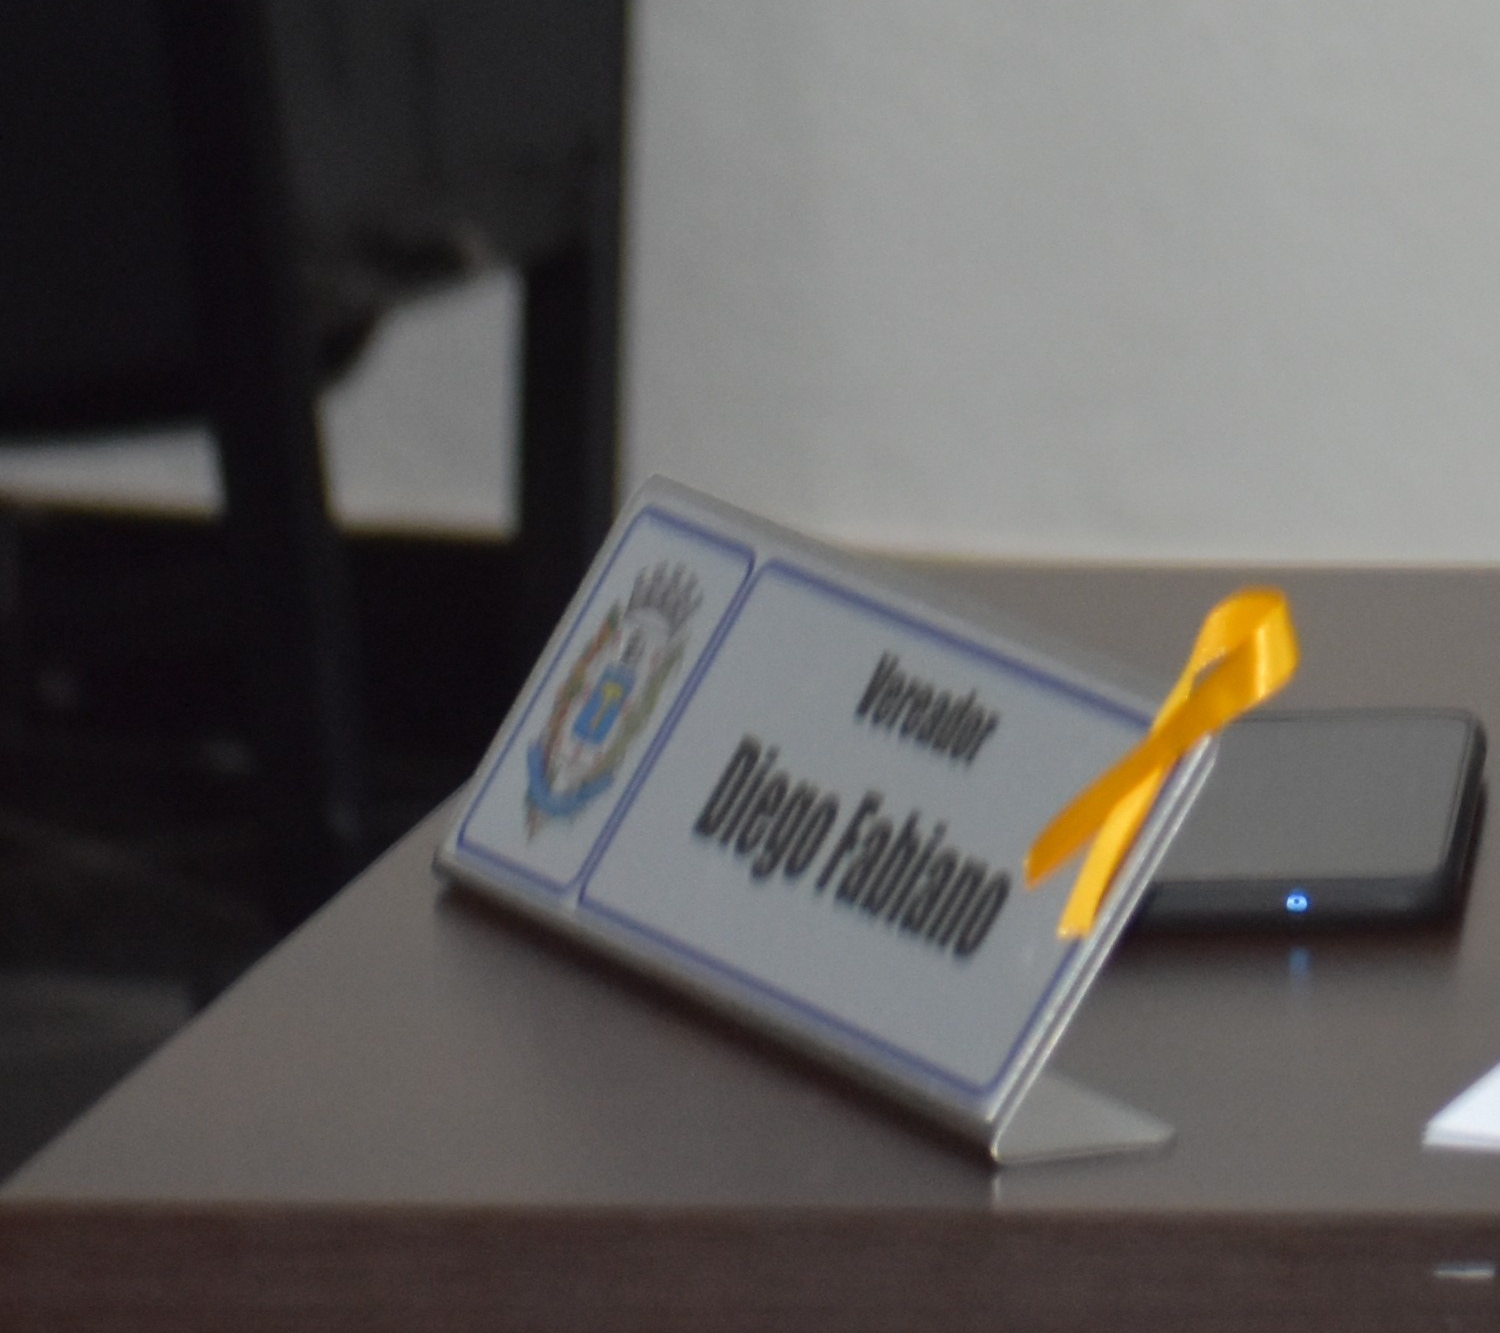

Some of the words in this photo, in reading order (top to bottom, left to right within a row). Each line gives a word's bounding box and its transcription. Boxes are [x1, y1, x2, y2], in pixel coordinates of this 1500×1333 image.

[855, 650, 999, 765] Vereador
[692, 733, 840, 882] Diego
[814, 789, 1012, 957] Fabiano
